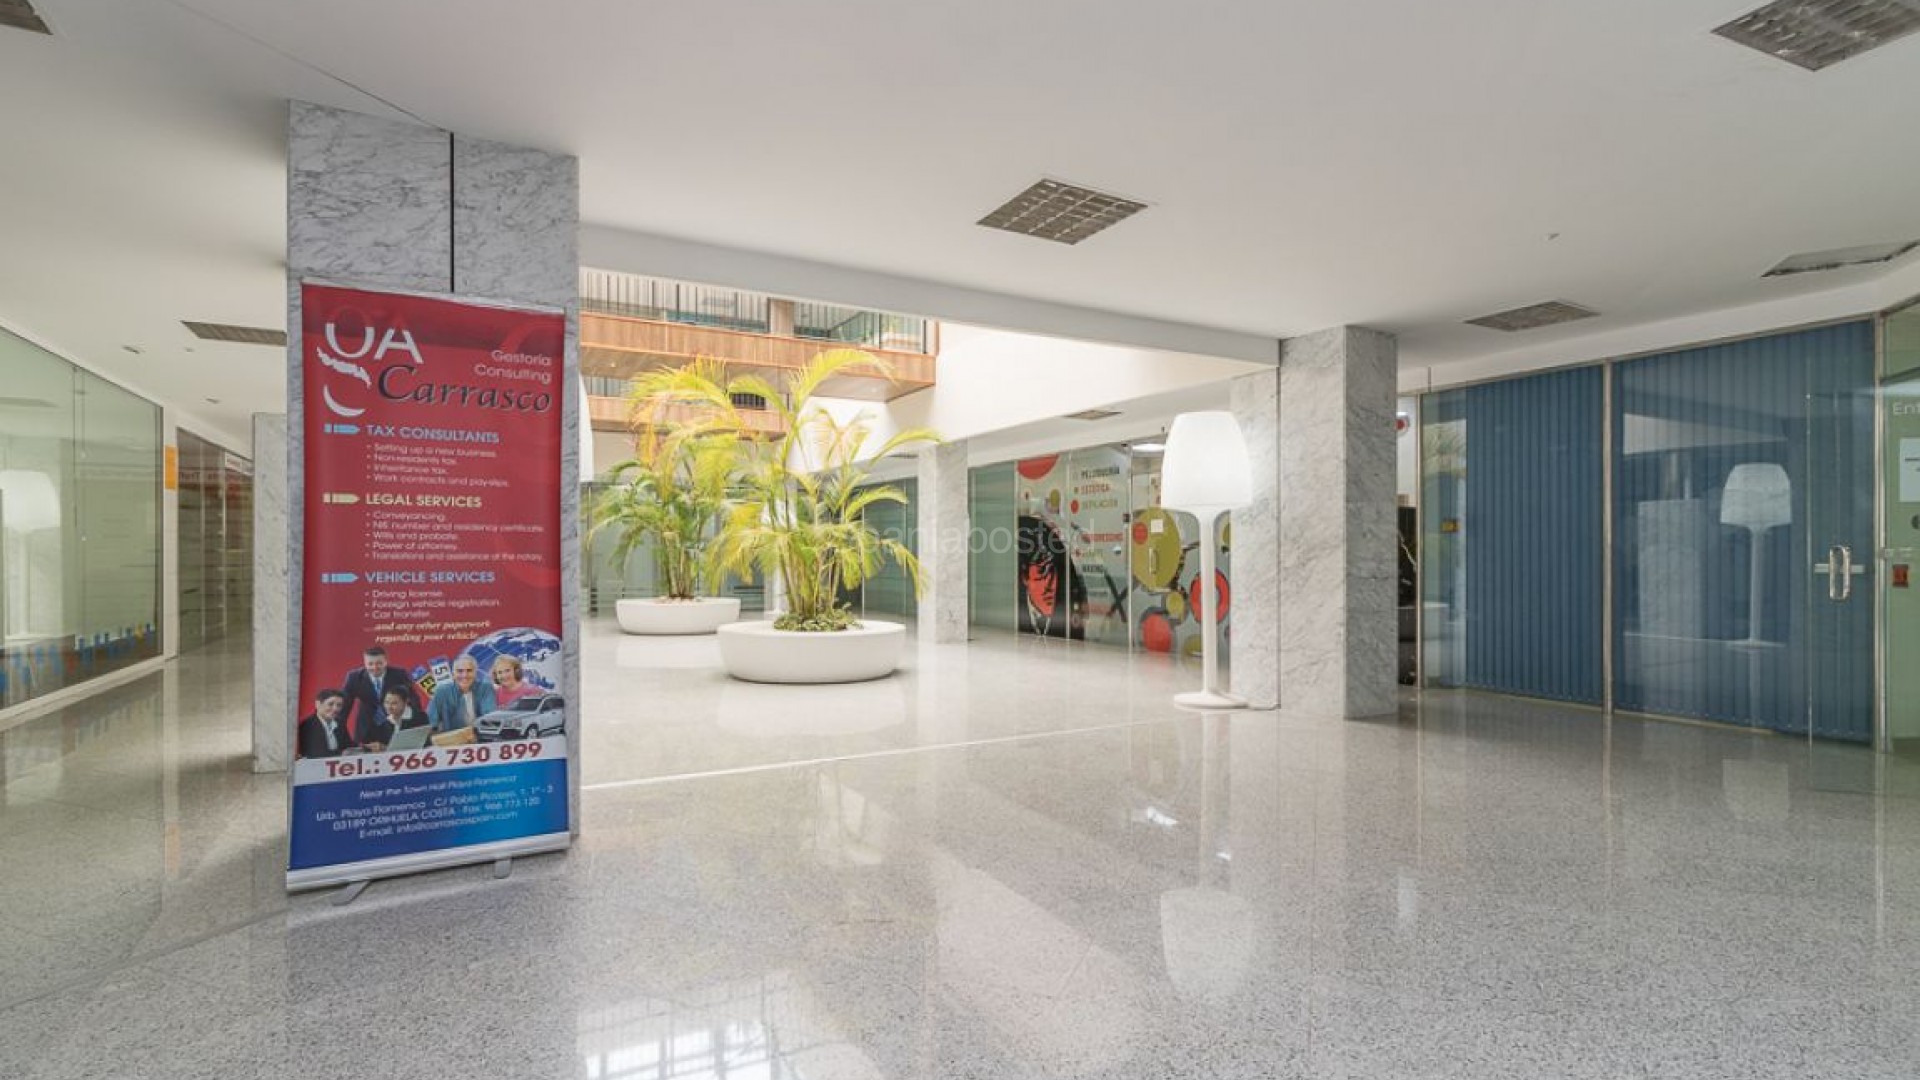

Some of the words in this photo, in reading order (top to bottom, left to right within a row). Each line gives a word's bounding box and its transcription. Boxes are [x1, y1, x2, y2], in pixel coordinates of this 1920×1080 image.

[474, 364, 551, 384] Consulting
[379, 365, 551, 412] Carrasco
[366, 425, 395, 437] TAX
[400, 427, 499, 443] CONSULTANTS
[374, 444, 407, 455] Setting
[366, 494, 412, 505] LEGAL
[417, 495, 482, 507] SERVICES
[392, 522, 430, 530] number
[373, 542, 403, 550] Power
[365, 571, 426, 583] VEHICLE
[429, 571, 496, 583] SERVICES
[372, 590, 407, 599] Driving
[372, 601, 409, 610] Foreign
[372, 610, 391, 619] Car
[396, 623, 414, 632] any
[416, 621, 441, 630] other
[442, 620, 491, 631] paperwork
[375, 632, 422, 643] regarding
[423, 634, 445, 642] your
[326, 759, 381, 778] Tel.:
[389, 752, 438, 772] 966
[446, 747, 491, 766] 730
[499, 741, 543, 761] 899
[341, 807, 372, 819] Playa
[373, 801, 427, 815] Flamenca
[421, 807, 456, 820] COSTA
